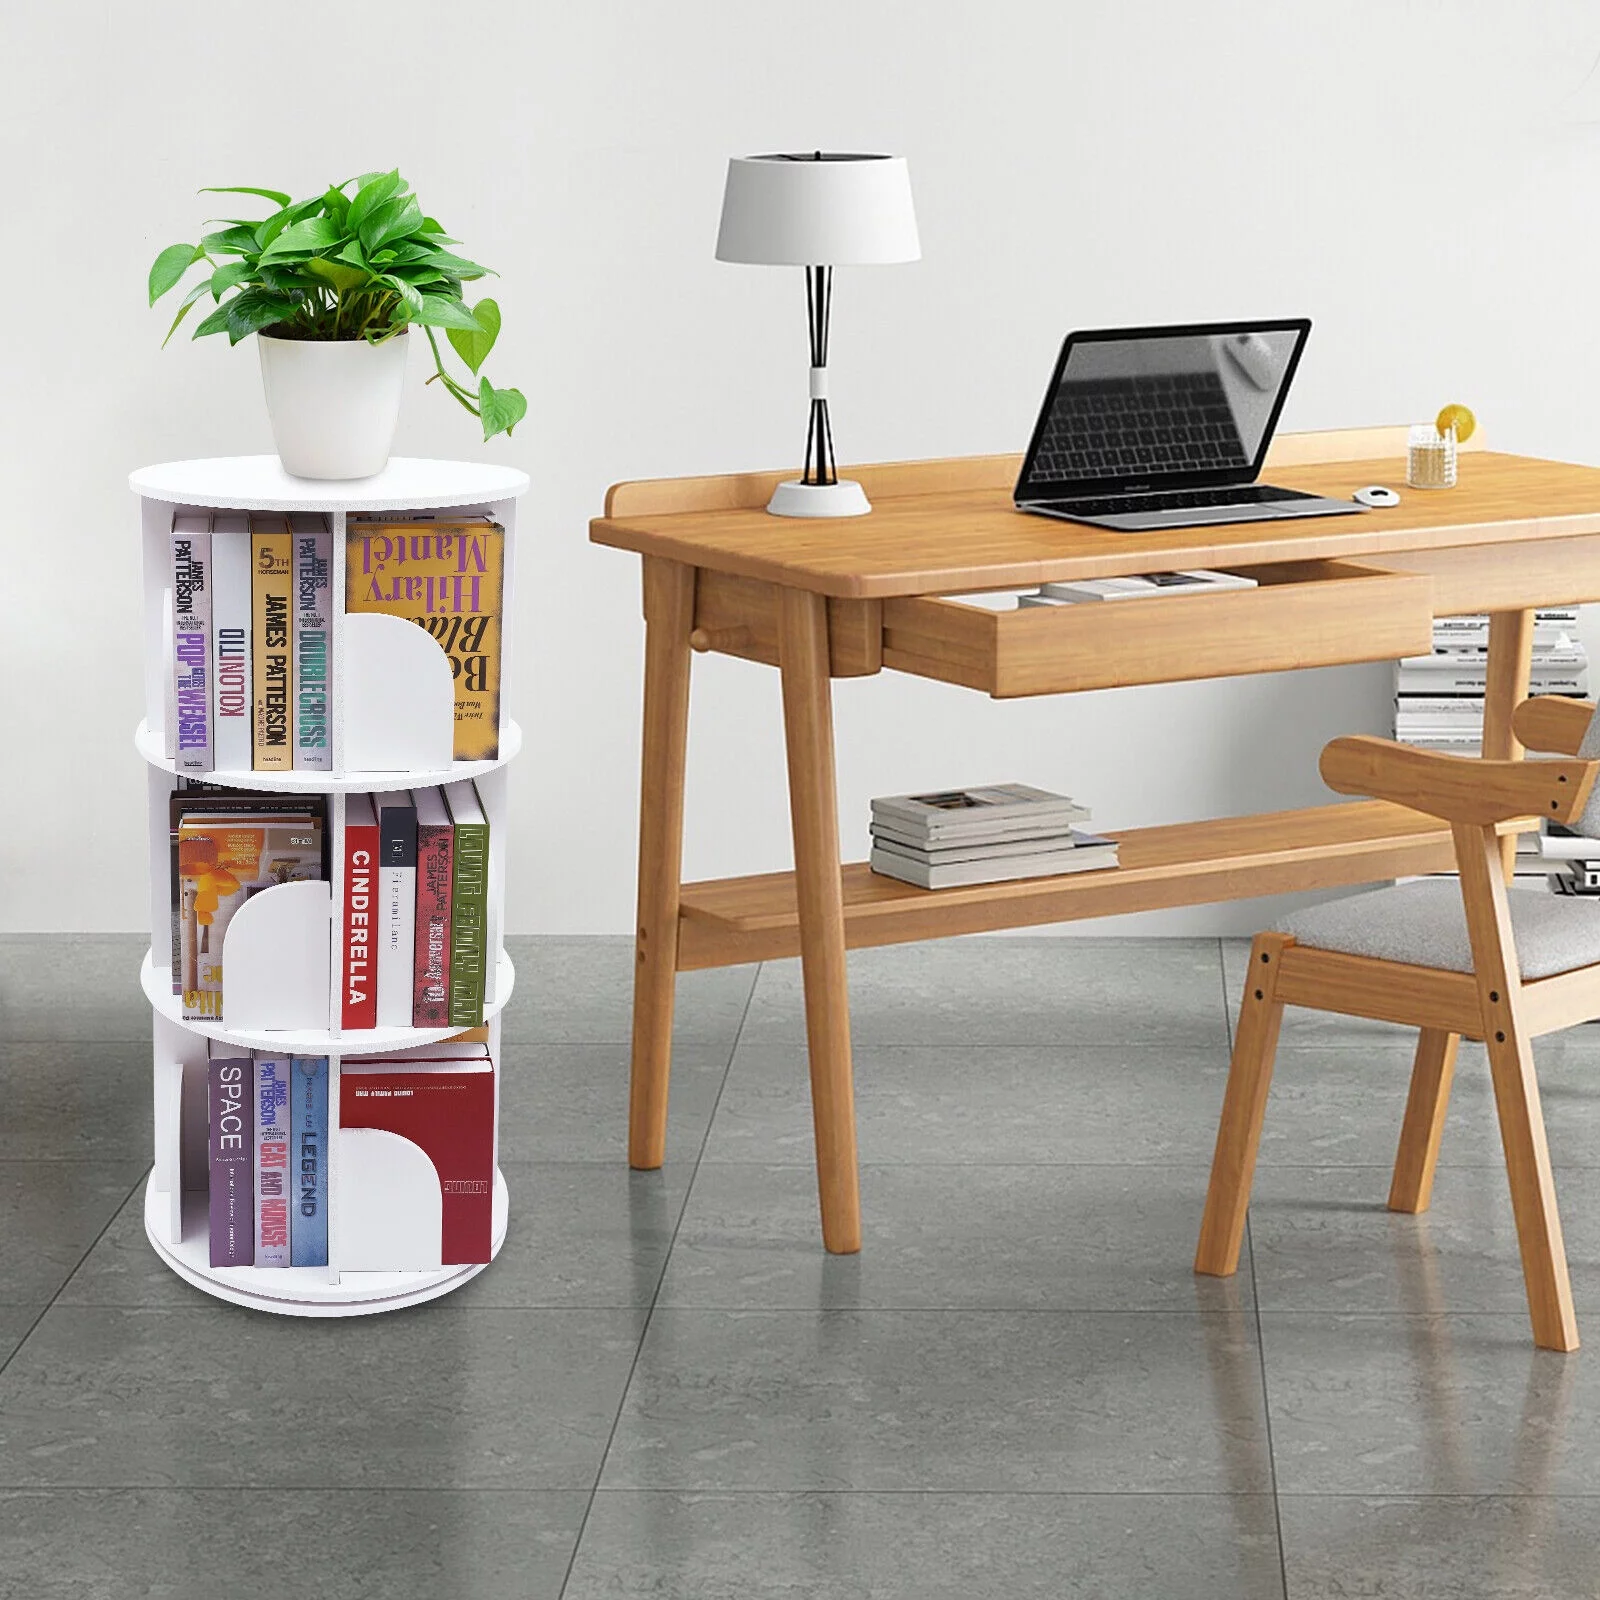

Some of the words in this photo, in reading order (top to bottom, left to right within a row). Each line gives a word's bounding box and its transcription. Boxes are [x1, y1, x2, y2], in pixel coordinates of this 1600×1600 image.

[175, 540, 192, 614] PATTERSON
[192, 560, 204, 592] JAMES
[299, 538, 316, 610] PATTERSON
[315, 558, 328, 588] JAMES
[362, 534, 490, 574] Mantel
[363, 564, 484, 613] Hilary
[265, 594, 286, 648] JAMES
[406, 615, 493, 654] Bla
[176, 633, 205, 666] POP
[219, 628, 245, 717] KOLONITID
[178, 688, 206, 750] WEASEL
[266, 655, 286, 746] PATTERSON
[426, 854, 437, 895] JAMES
[436, 838, 450, 911] PATTERSON
[349, 850, 370, 1004] CINDERELLA
[184, 989, 223, 1016] lita
[220, 1066, 242, 1150] SPACE
[260, 1062, 276, 1126] PATTERSON
[275, 1080, 287, 1106] JAMES
[260, 1142, 287, 1168] CAT
[301, 1132, 317, 1218] LEGEND
[260, 1171, 282, 1196] AND
[261, 1198, 287, 1248] MOUSE
